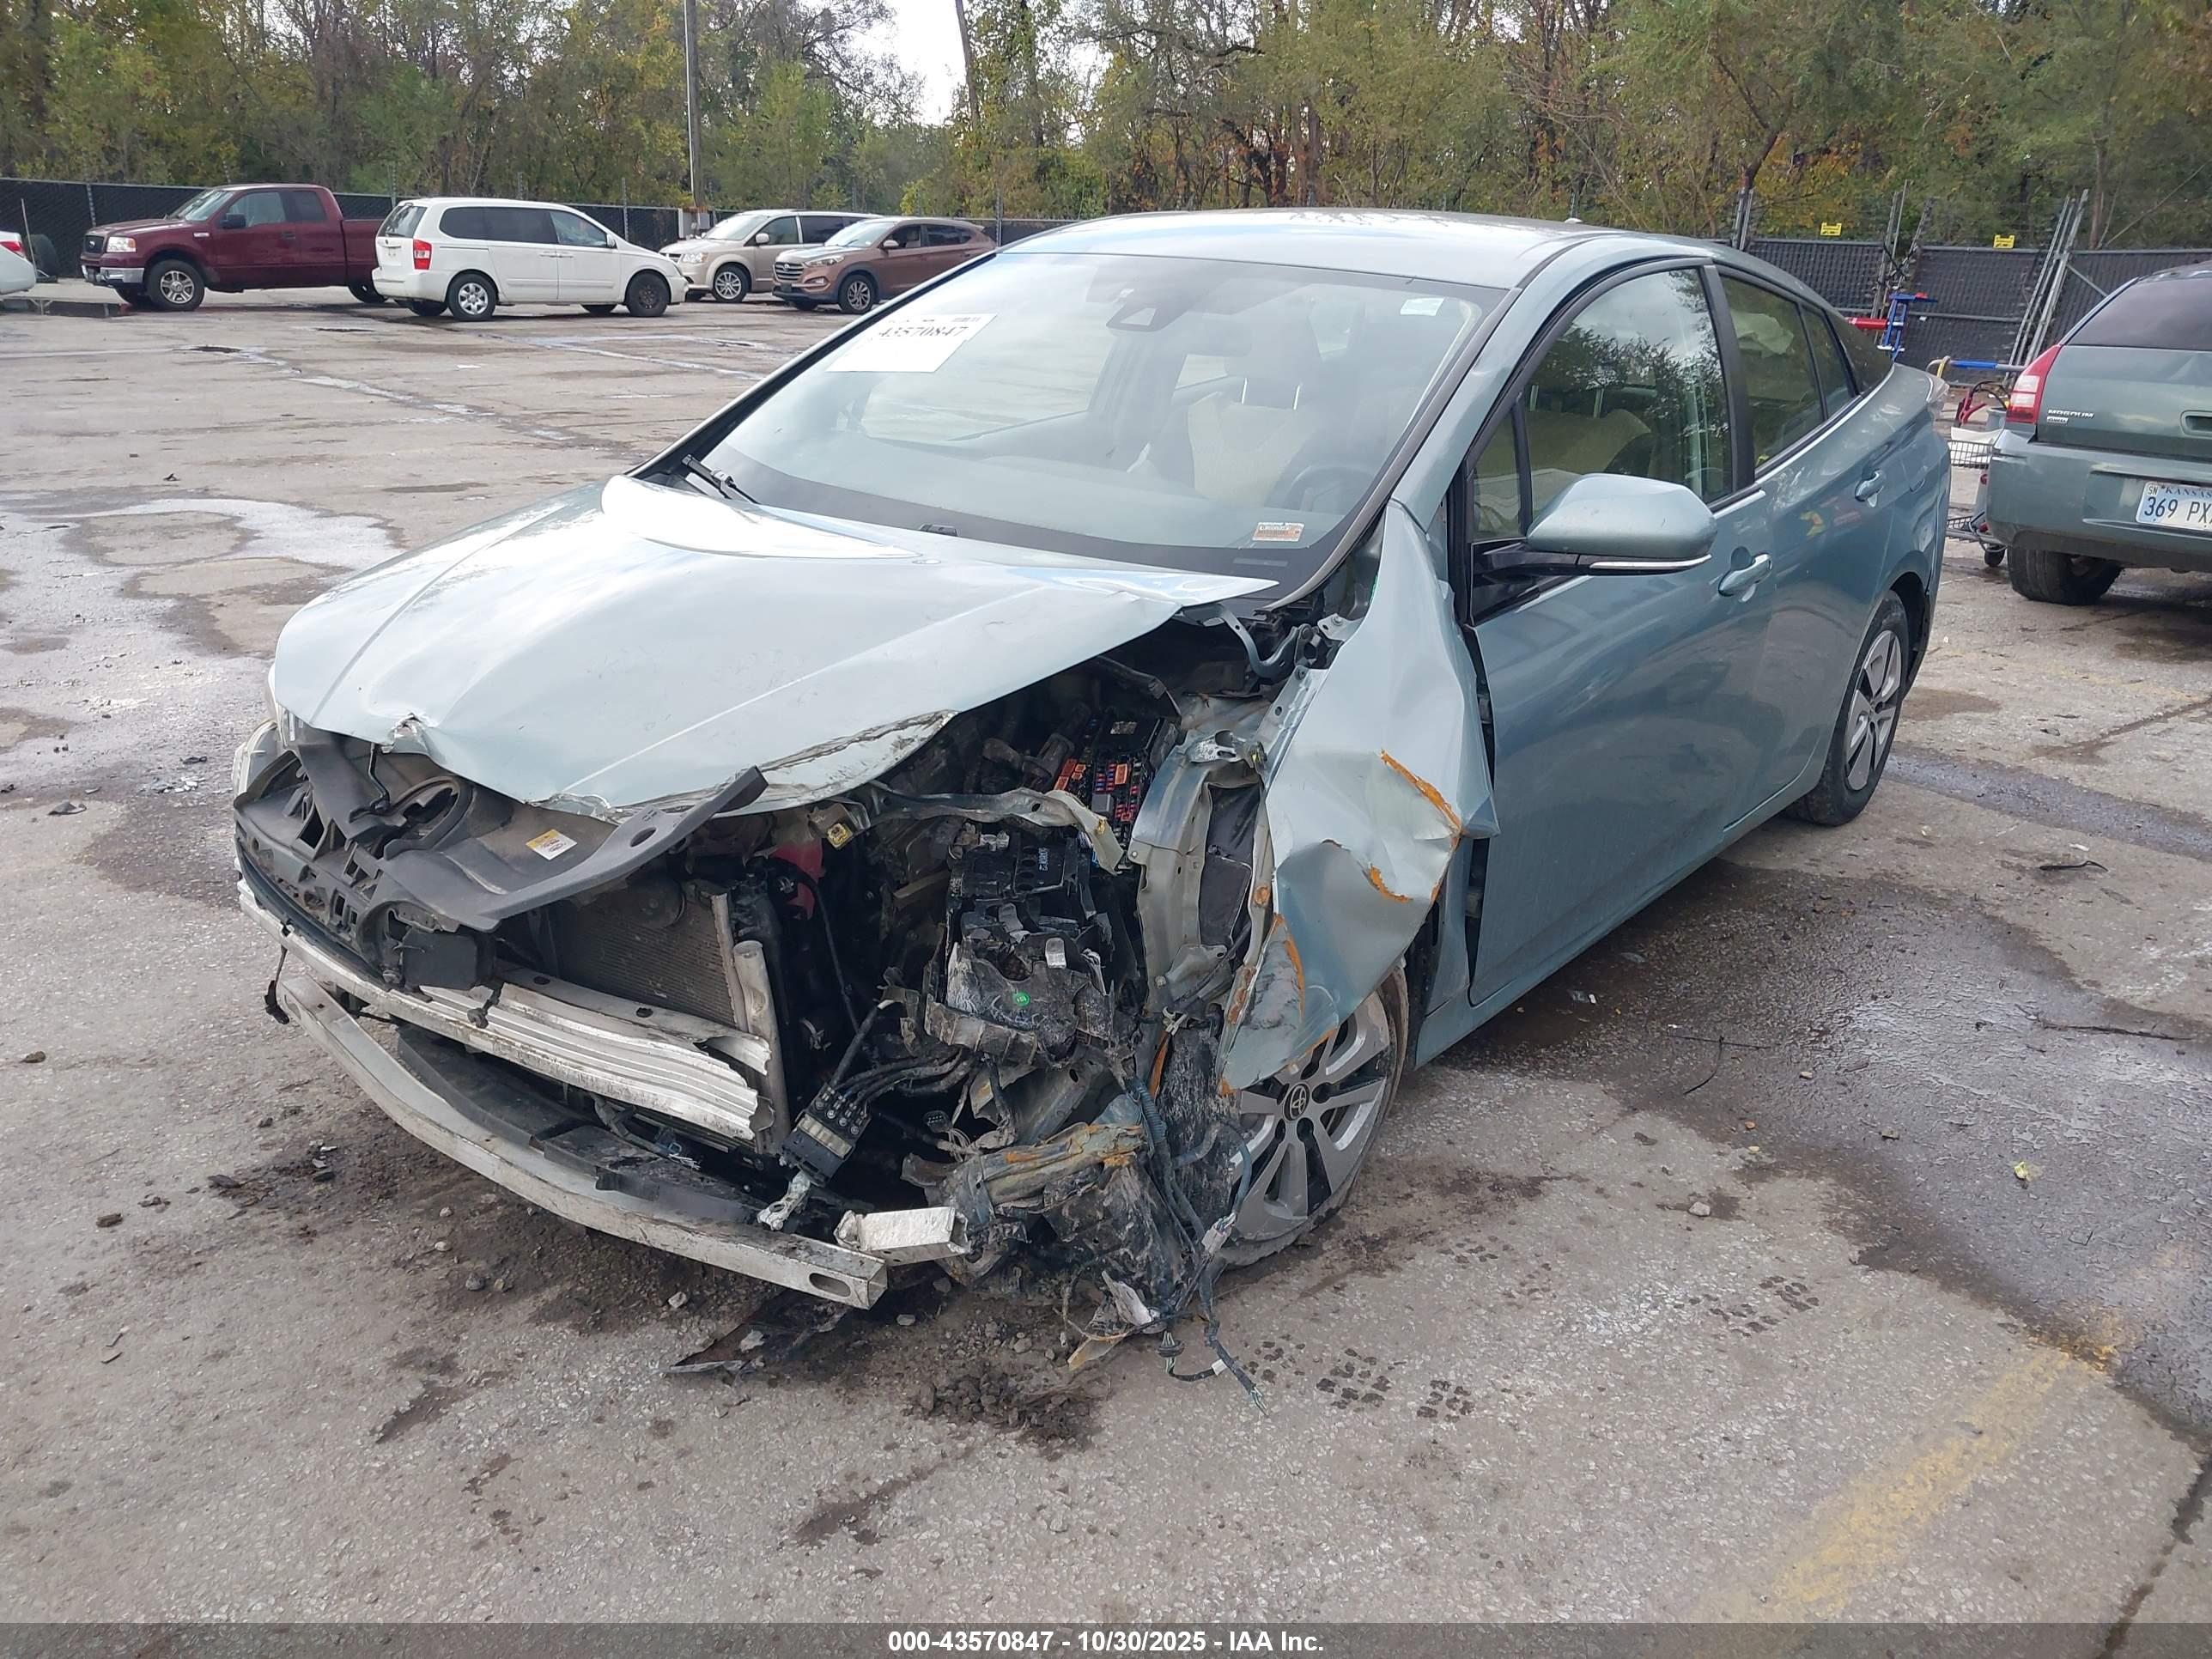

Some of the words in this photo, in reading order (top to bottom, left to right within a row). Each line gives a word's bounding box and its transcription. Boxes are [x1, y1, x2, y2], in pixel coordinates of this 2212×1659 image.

[2148, 485, 2158, 495] SN
[2166, 487, 2212, 498] KANSAS
[2144, 496, 2179, 519] 369
[2186, 501, 2212, 524] PX
